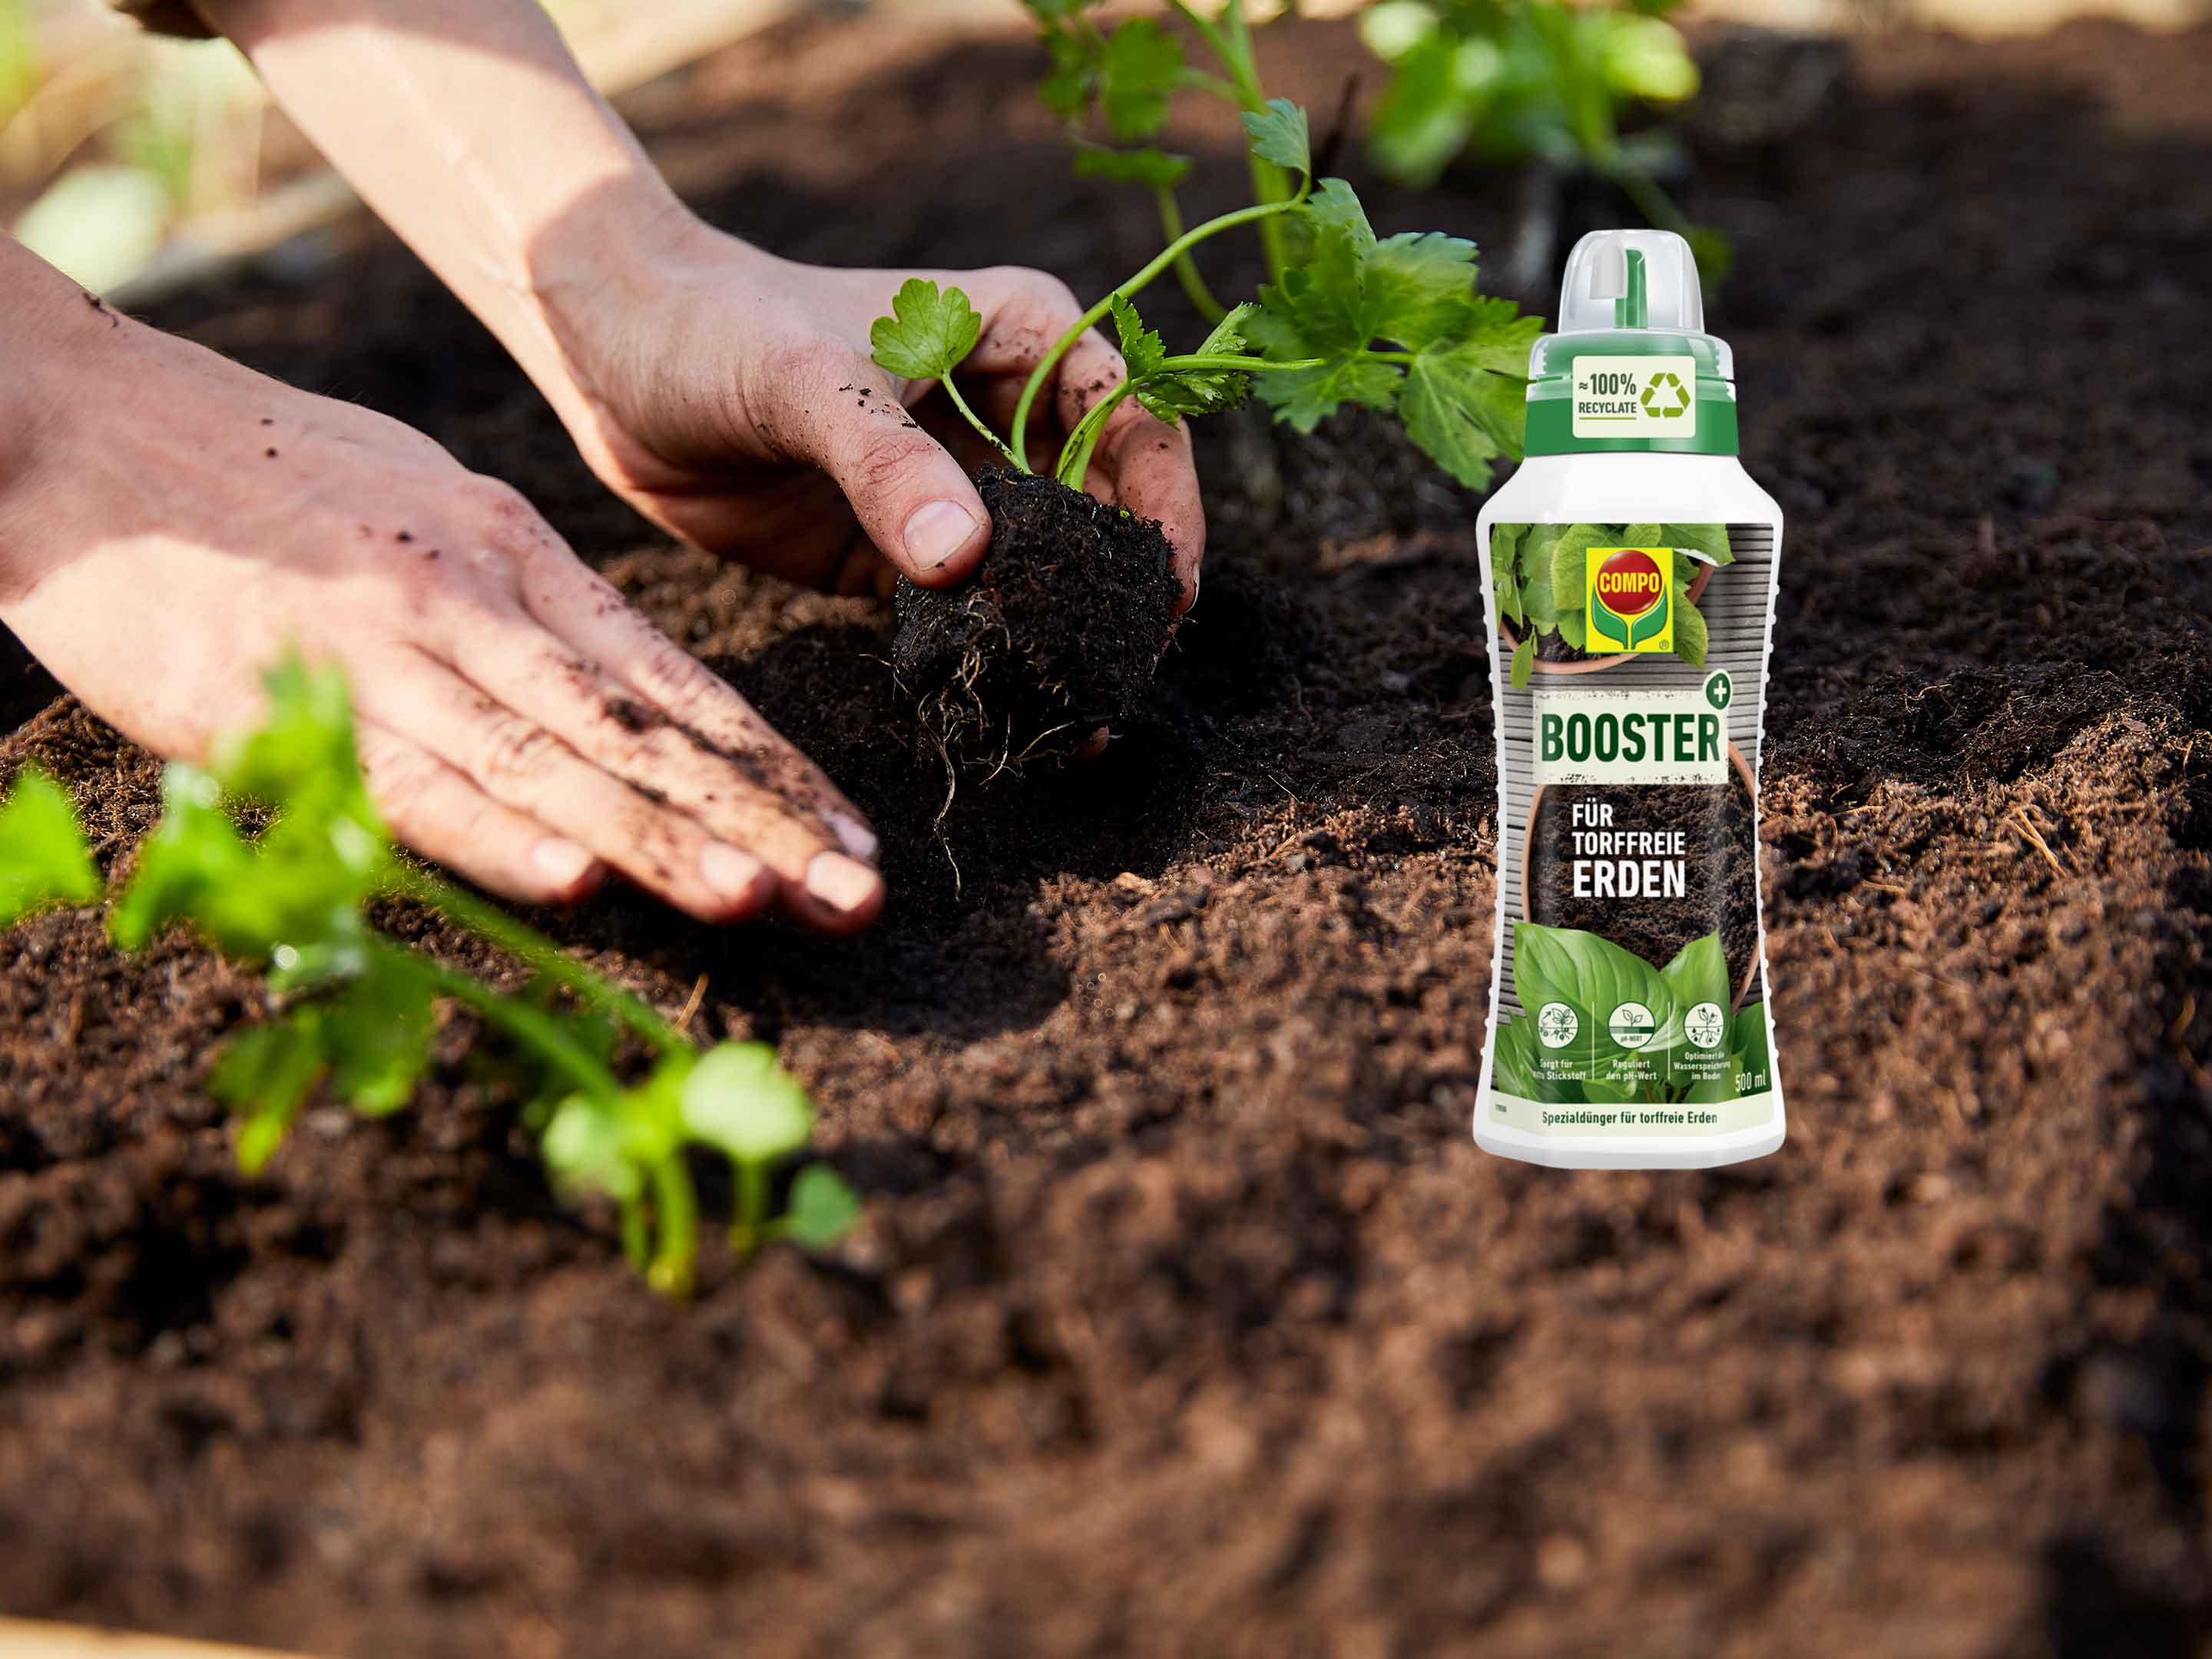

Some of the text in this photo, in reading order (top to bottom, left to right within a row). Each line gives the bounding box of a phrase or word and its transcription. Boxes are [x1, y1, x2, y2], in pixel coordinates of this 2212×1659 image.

[1578, 402, 1637, 414] RECYCLATE
[1599, 572, 1659, 594] COMPO
[1541, 713, 1720, 763] BOOSTER
[1572, 797, 1614, 827] FÜR
[1571, 832, 1686, 856] TORFFREIE
[1573, 859, 1686, 898] ERDEN
[1612, 1058, 1651, 1071] Reguliert
[1546, 1071, 1587, 1081] Stickstoff
[1605, 1071, 1657, 1082] den pH-Wert
[1735, 1068, 1767, 1093] 500 ml
[1541, 1111, 1718, 1126] Spezialdünger für torffreie Erden
